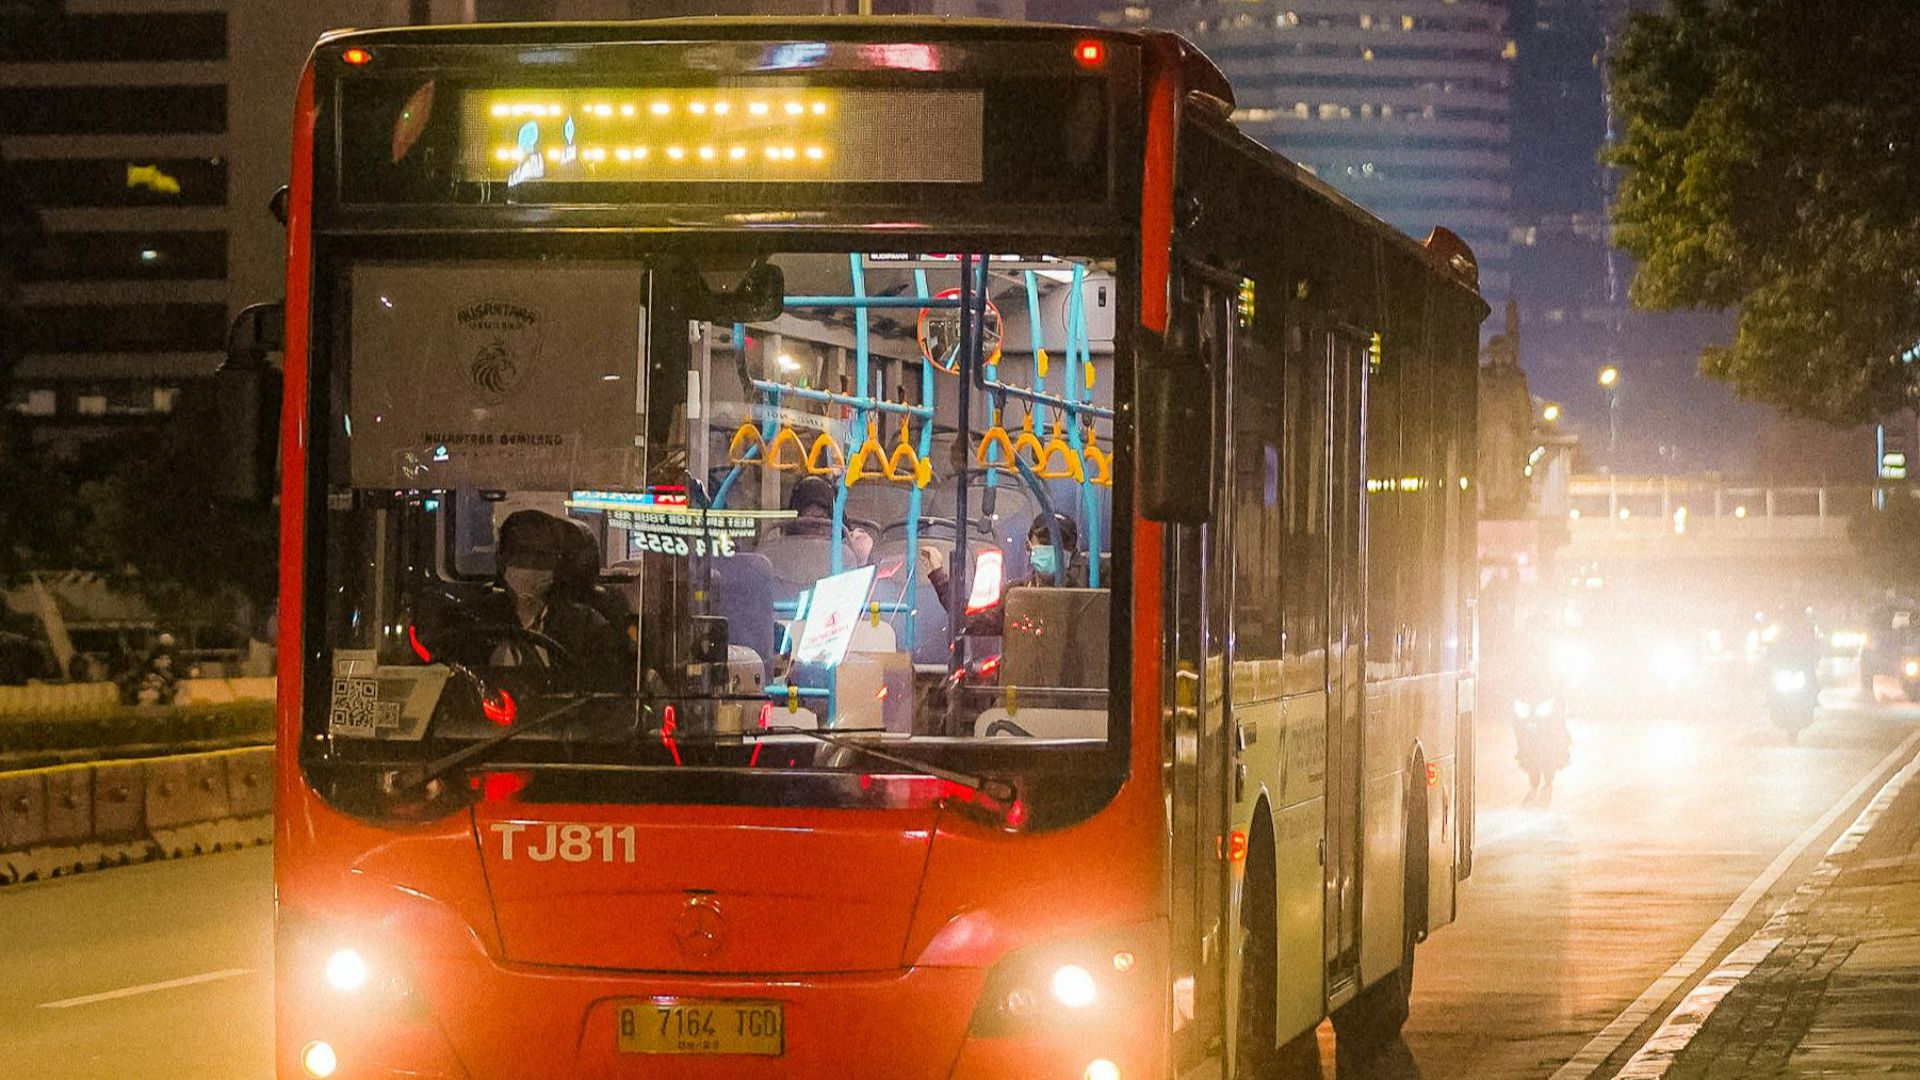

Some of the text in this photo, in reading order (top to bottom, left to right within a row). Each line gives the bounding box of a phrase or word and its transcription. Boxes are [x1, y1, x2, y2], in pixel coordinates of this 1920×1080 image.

[490, 823, 636, 863] TJ811
[621, 1008, 635, 1037] B
[657, 1008, 716, 1037] 7164
